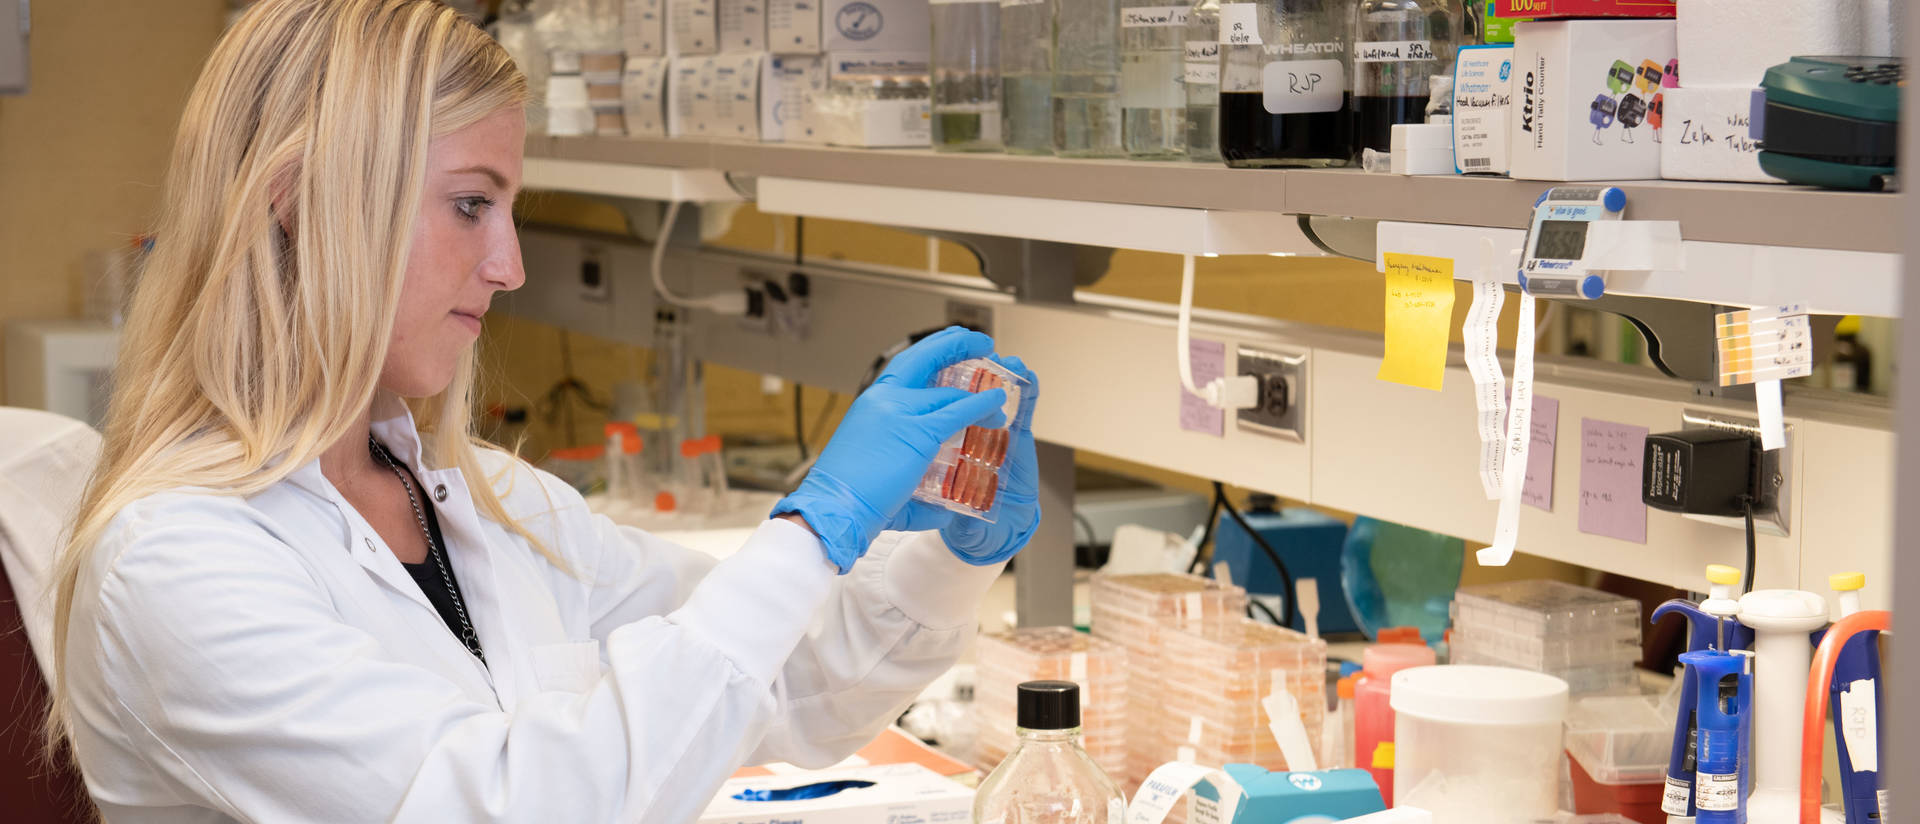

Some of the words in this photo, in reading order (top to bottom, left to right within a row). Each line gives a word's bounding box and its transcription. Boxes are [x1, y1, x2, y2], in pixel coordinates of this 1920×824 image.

[1263, 42, 1344, 55] WHEATON
[1288, 71, 1322, 95] RJP
[1522, 71, 1534, 132] Ktrio
[1510, 407, 1526, 457] DISTURB
